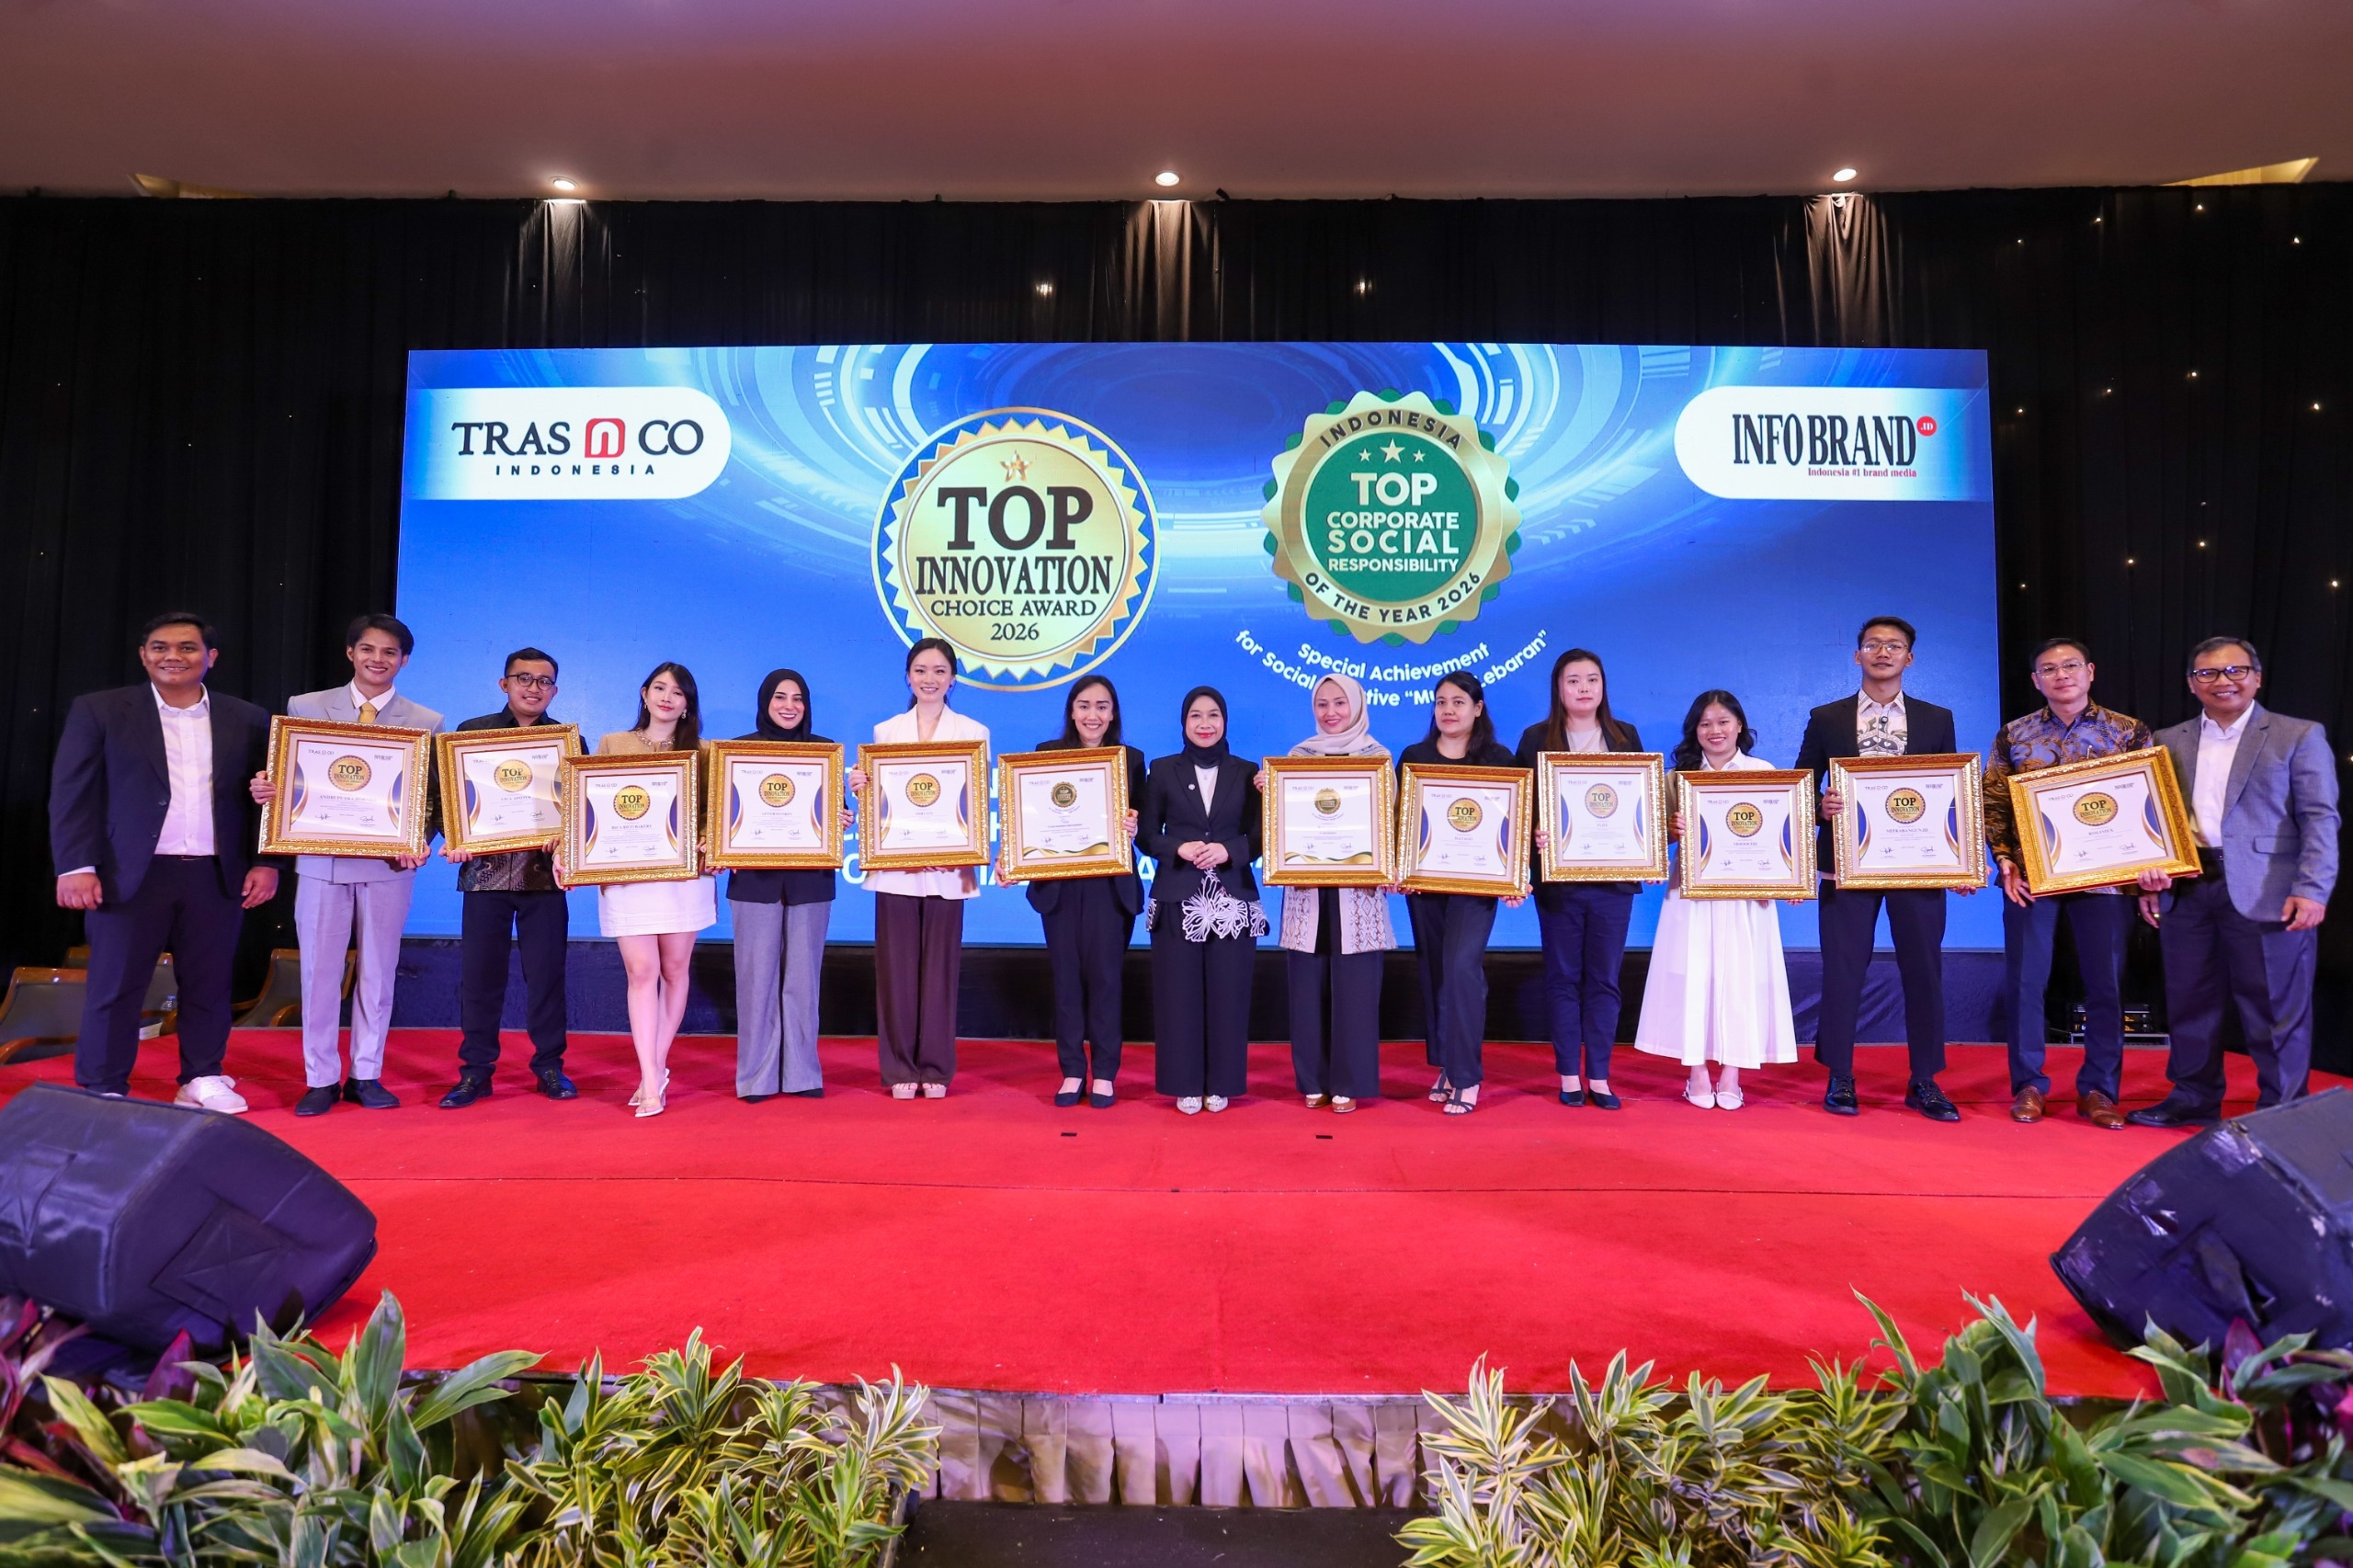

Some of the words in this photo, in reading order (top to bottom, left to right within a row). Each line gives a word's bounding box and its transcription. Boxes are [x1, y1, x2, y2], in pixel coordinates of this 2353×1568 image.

[1319, 409, 1461, 450] INDONESIA
[496, 464, 654, 475] INDONESIA
[1808, 467, 1850, 477] Indonesia
[1852, 468, 1861, 477] #1
[1863, 468, 1889, 478] brand
[1891, 469, 1917, 478] media
[1350, 472, 1438, 506] TOP
[937, 485, 1094, 551] TOP
[1326, 511, 1460, 529] CORPORATE
[1327, 529, 1460, 554] SOCIAL
[1328, 558, 1460, 573] RESPONSIBILITY
[915, 555, 1114, 596] INNOVATION
[1304, 572, 1330, 596] OF
[1332, 593, 1371, 620] THE
[1379, 604, 1433, 624] YEAR
[1437, 571, 1481, 611] 2026
[930, 599, 1014, 617] CHOICE
[1019, 599, 1097, 617] AWARD
[990, 622, 1040, 641] 2026
[1234, 630, 1264, 655] for
[1262, 652, 1317, 690] Social
[1297, 642, 1367, 679] Special
[1369, 642, 1490, 681] Achievement
[337, 764, 363, 775] TOP
[501, 767, 524, 778] TOP
[334, 773, 366, 781] INNOVATION
[767, 782, 788, 791] TOP
[913, 782, 934, 791] TOP
[621, 794, 642, 804] TOP
[1592, 792, 1611, 801] TOP
[1893, 797, 1916, 807] TOP
[1455, 806, 1475, 816] TOP
[2081, 800, 2107, 812] TOP
[1733, 812, 1755, 821] TOP
